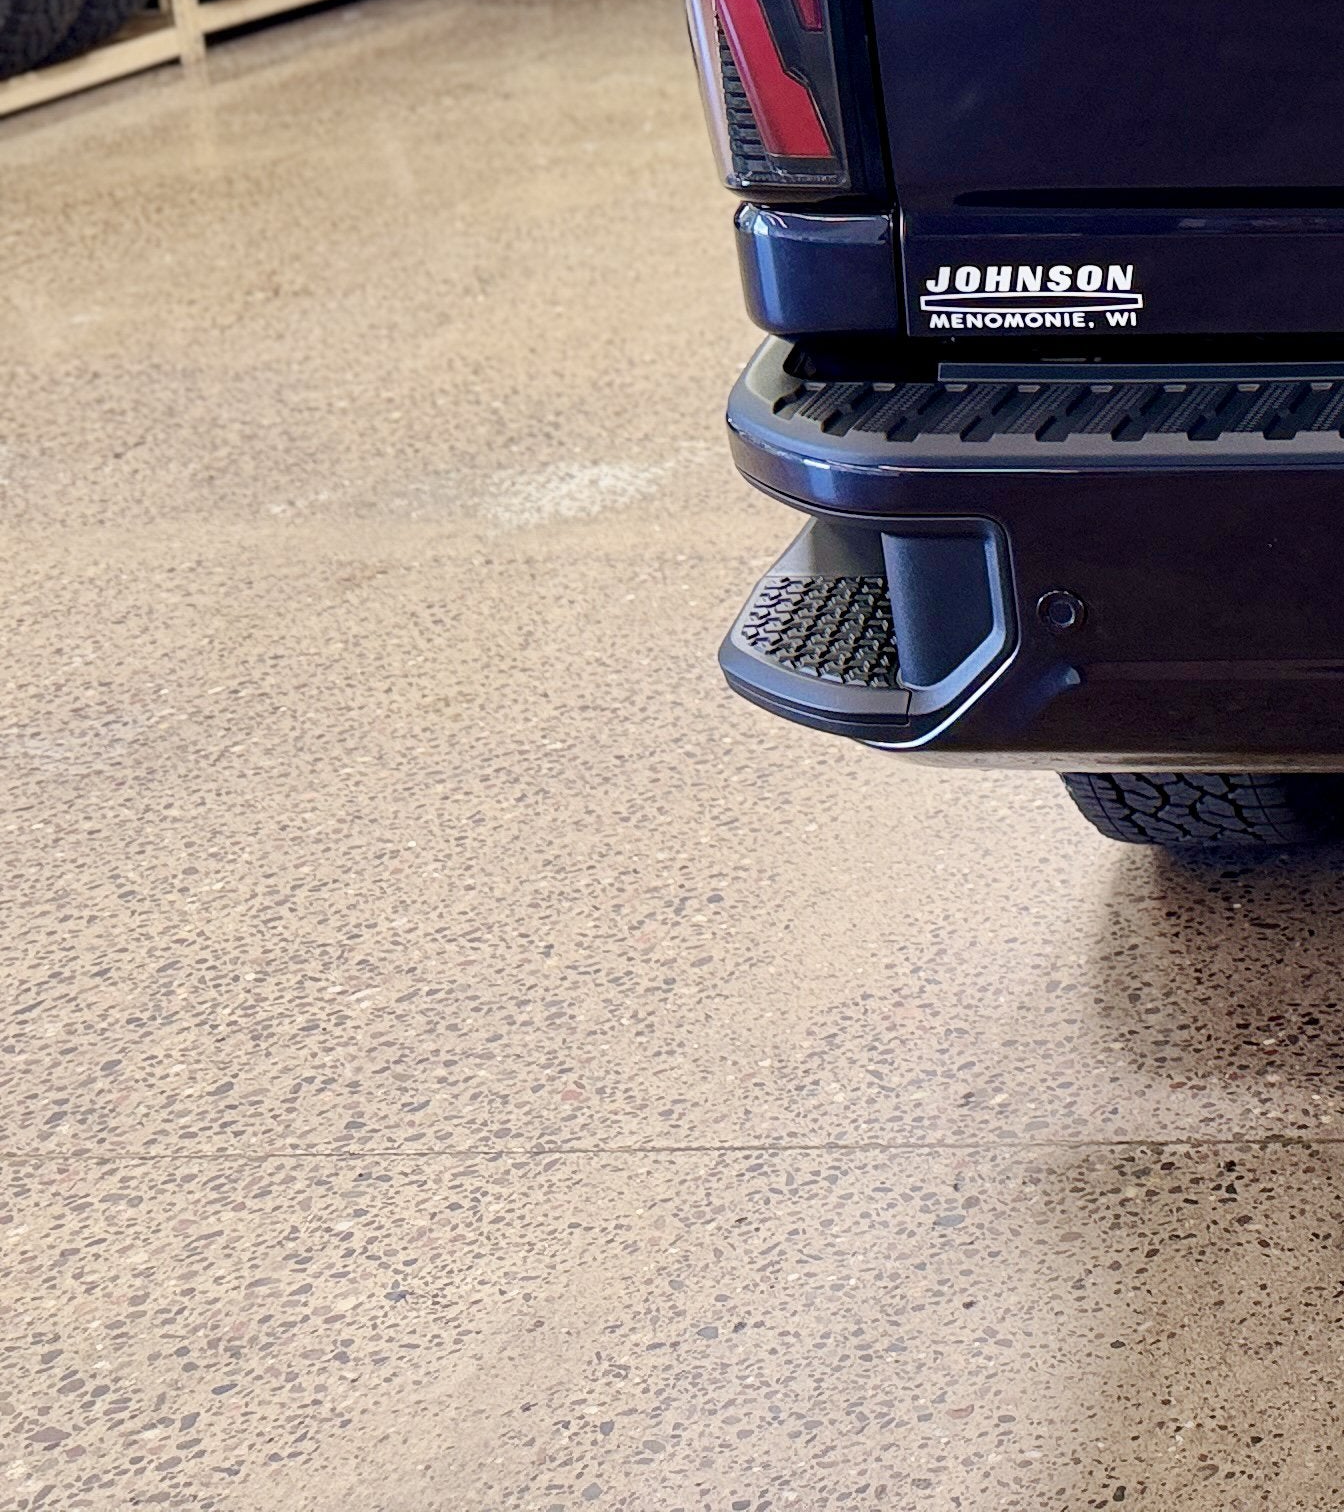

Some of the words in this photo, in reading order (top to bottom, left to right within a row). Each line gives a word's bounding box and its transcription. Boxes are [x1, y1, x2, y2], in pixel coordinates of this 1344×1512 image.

[925, 264, 1134, 293] JOHNSON
[928, 311, 1095, 329] MENOMONIE,
[1104, 311, 1137, 327] WI
